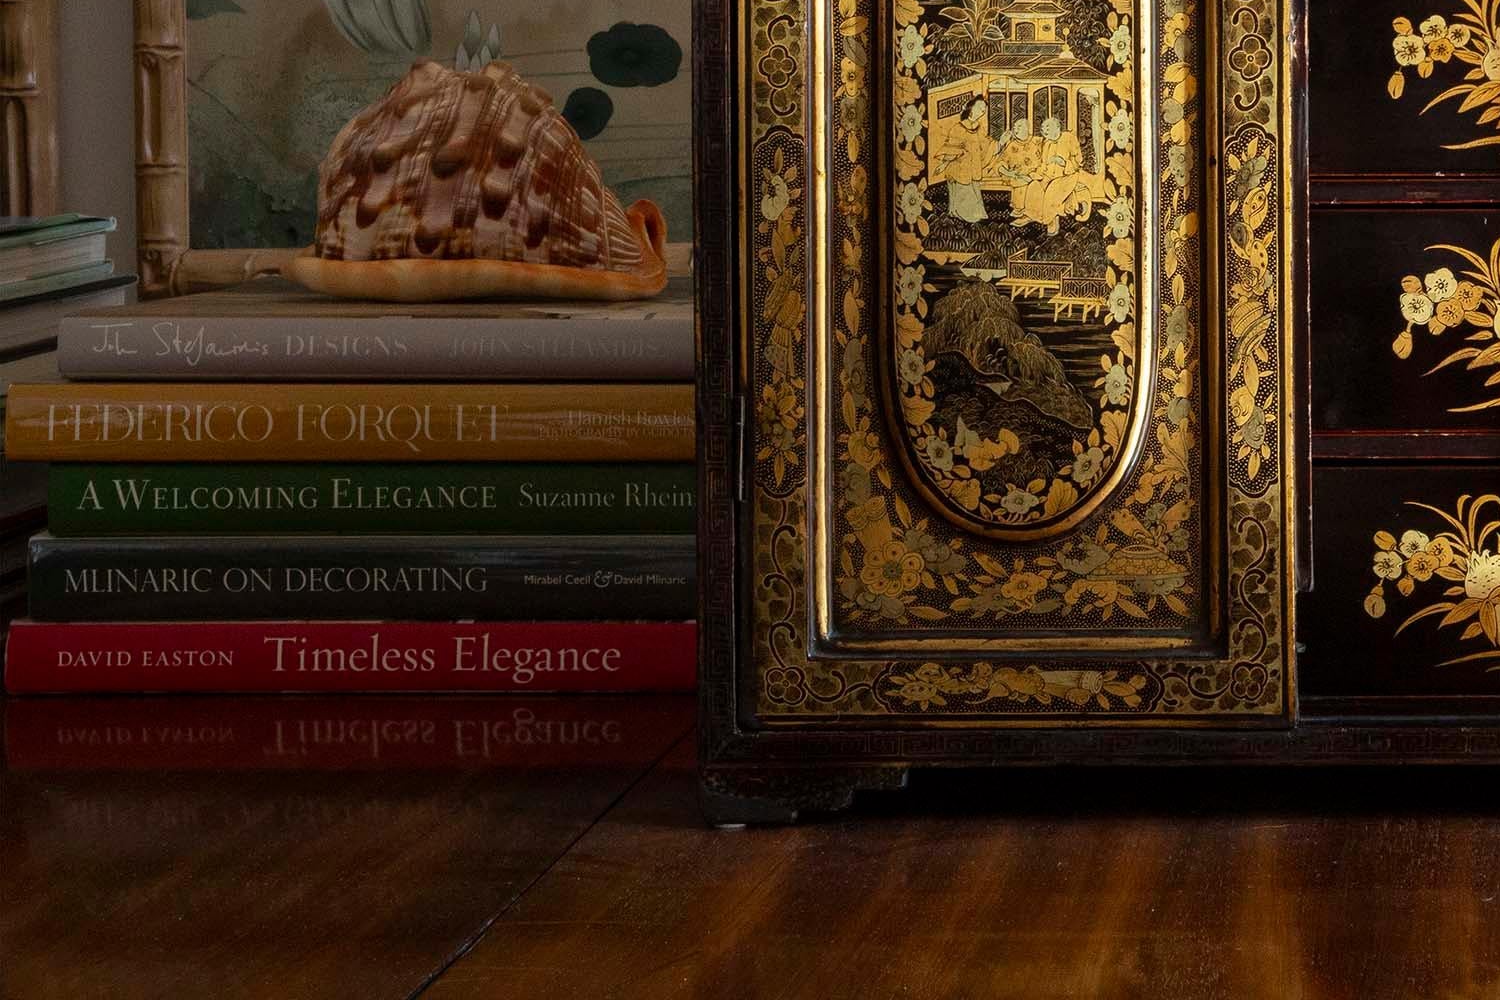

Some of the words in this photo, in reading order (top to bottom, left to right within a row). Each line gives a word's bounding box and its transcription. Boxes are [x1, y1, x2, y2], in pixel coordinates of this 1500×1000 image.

[285, 334, 408, 357] DESIGNS
[47, 402, 275, 442] FEDERICO
[296, 401, 512, 451] FORQUET
[77, 478, 104, 510] A
[518, 480, 616, 509] Suzanne
[624, 480, 697, 508] Rhein
[64, 567, 214, 594] MLINARIC
[222, 567, 273, 594] ON
[284, 566, 489, 594] DECORATING
[523, 572, 563, 586] Mirabel
[564, 572, 591, 586] Cecil
[592, 569, 612, 588] &
[613, 572, 643, 586] David
[645, 572, 688, 586] Mlinaric
[57, 650, 132, 668] DAVID
[141, 650, 235, 668] EASTON
[264, 636, 436, 674] Timeless
[452, 632, 623, 684] Elegance
